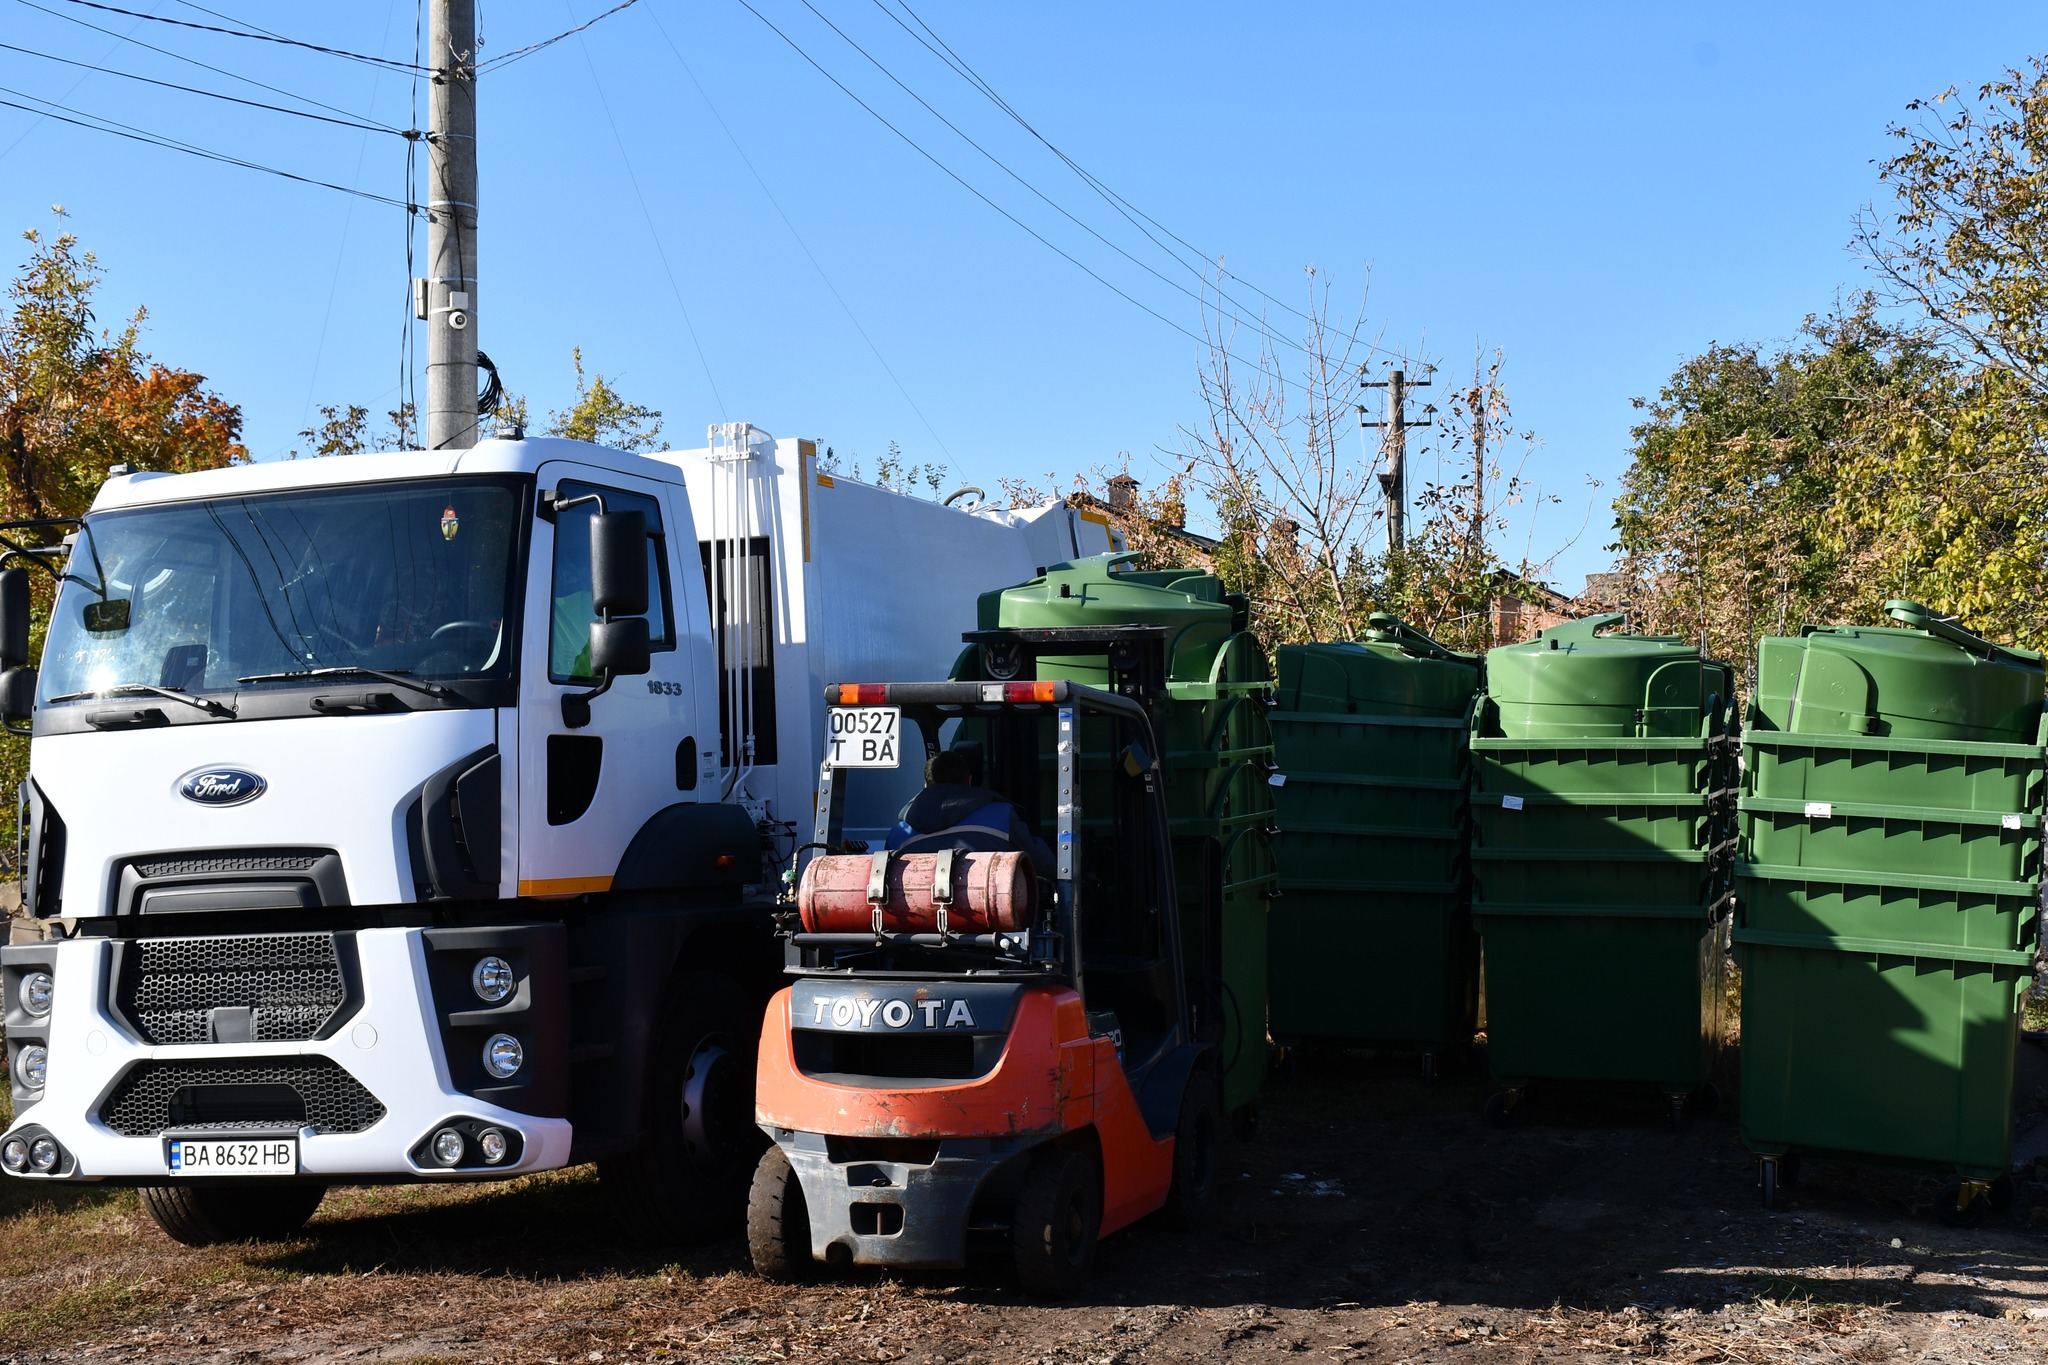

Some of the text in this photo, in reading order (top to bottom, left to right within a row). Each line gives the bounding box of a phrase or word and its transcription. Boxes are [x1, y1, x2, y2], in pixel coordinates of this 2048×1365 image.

[647, 680, 682, 696] 1833
[831, 712, 895, 734] 00527
[830, 739, 894, 761] T BA
[194, 774, 241, 797] Ford
[812, 995, 978, 1029] TOYOTA
[184, 1143, 290, 1166] BA 8632 HB
